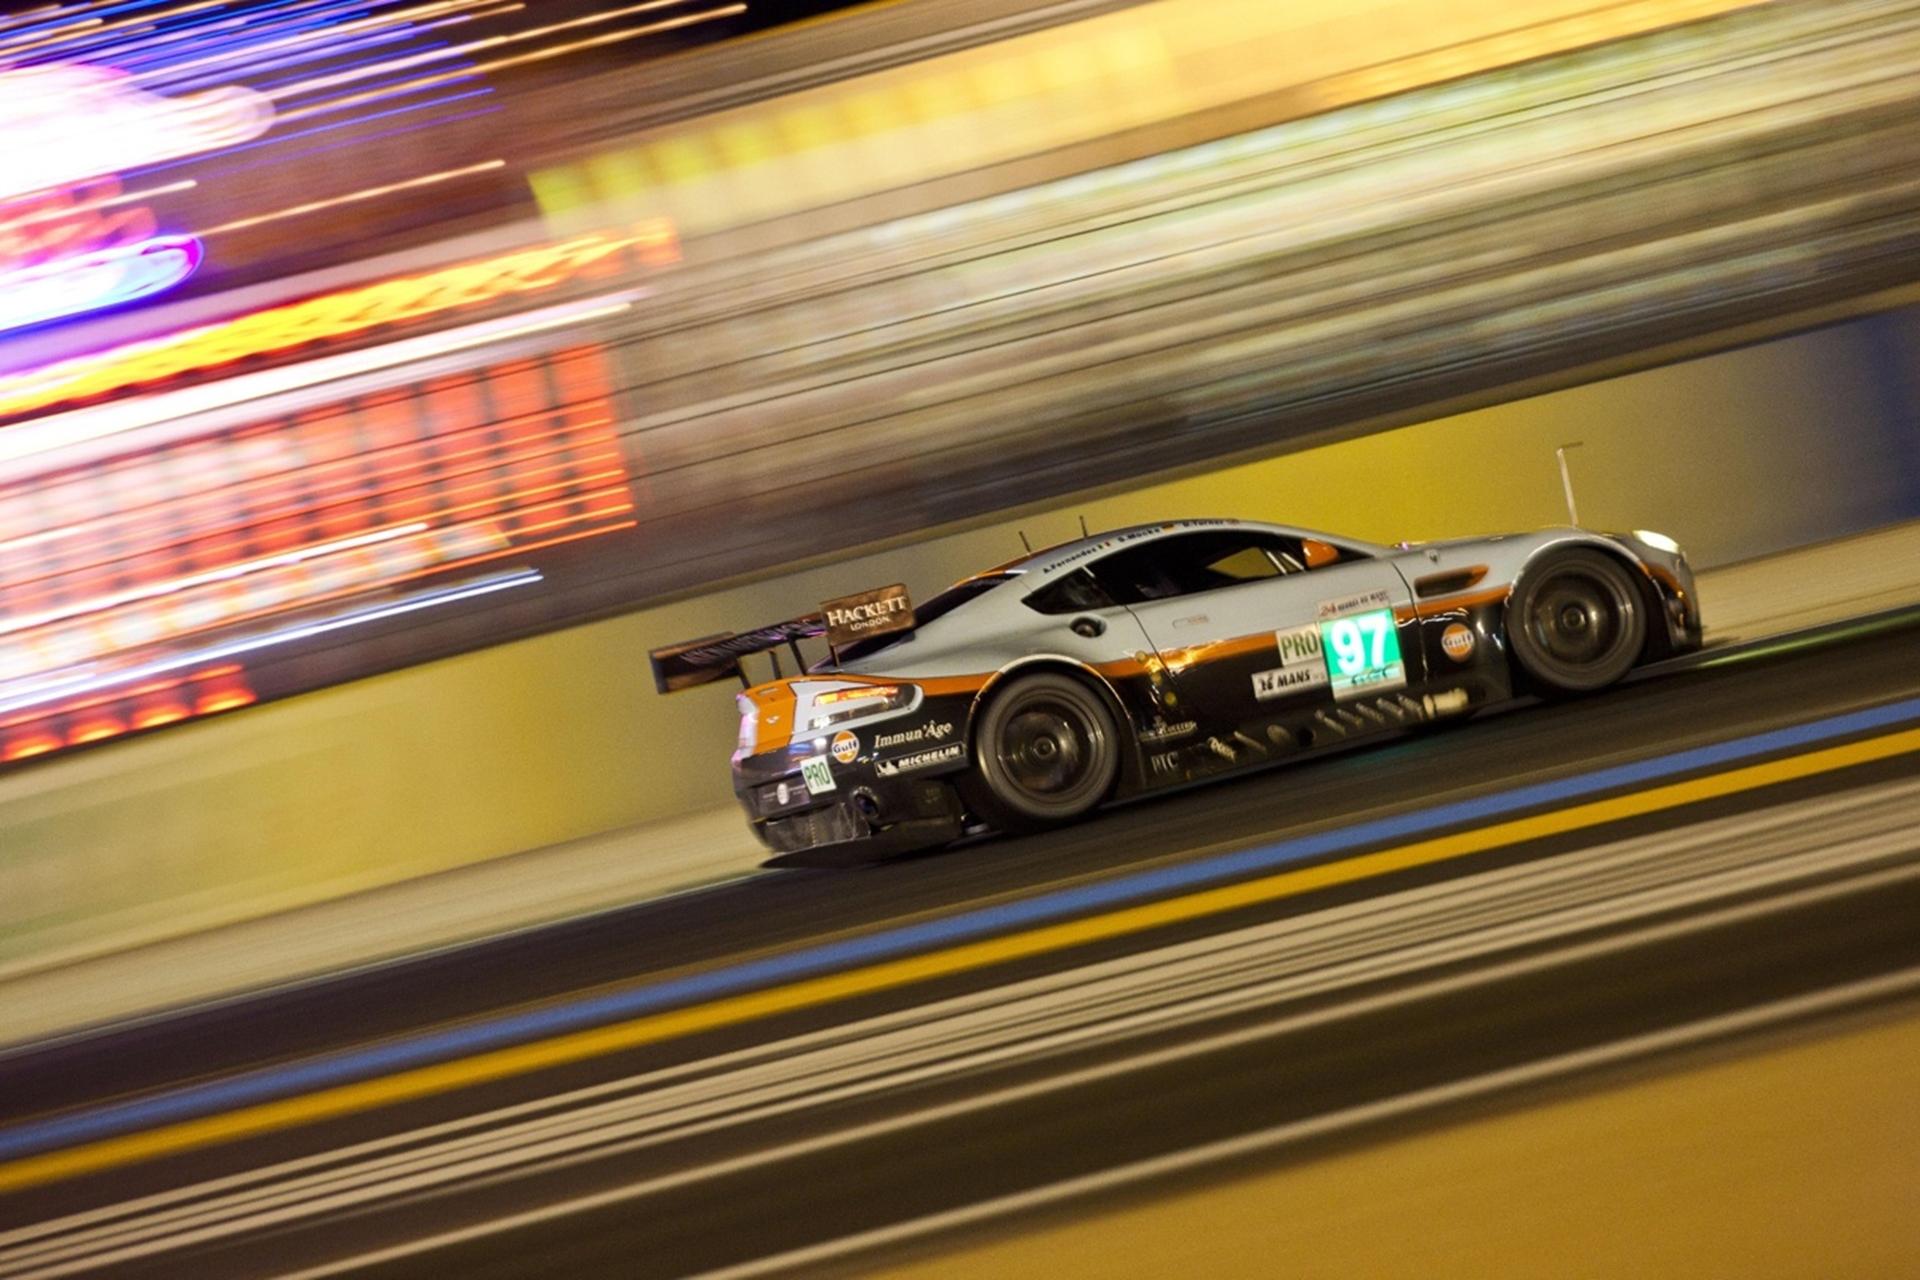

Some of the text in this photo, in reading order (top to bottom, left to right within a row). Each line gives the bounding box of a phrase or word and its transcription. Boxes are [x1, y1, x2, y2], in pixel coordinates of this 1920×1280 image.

[826, 596, 907, 627] HACKETT
[850, 615, 892, 631] LONDON
[1280, 630, 1318, 660] PRO
[1331, 616, 1388, 676] 97
[1277, 669, 1311, 688] MANS
[833, 738, 858, 754] Gulf
[898, 745, 960, 768] MICHELIN
[804, 759, 831, 788] PRO
